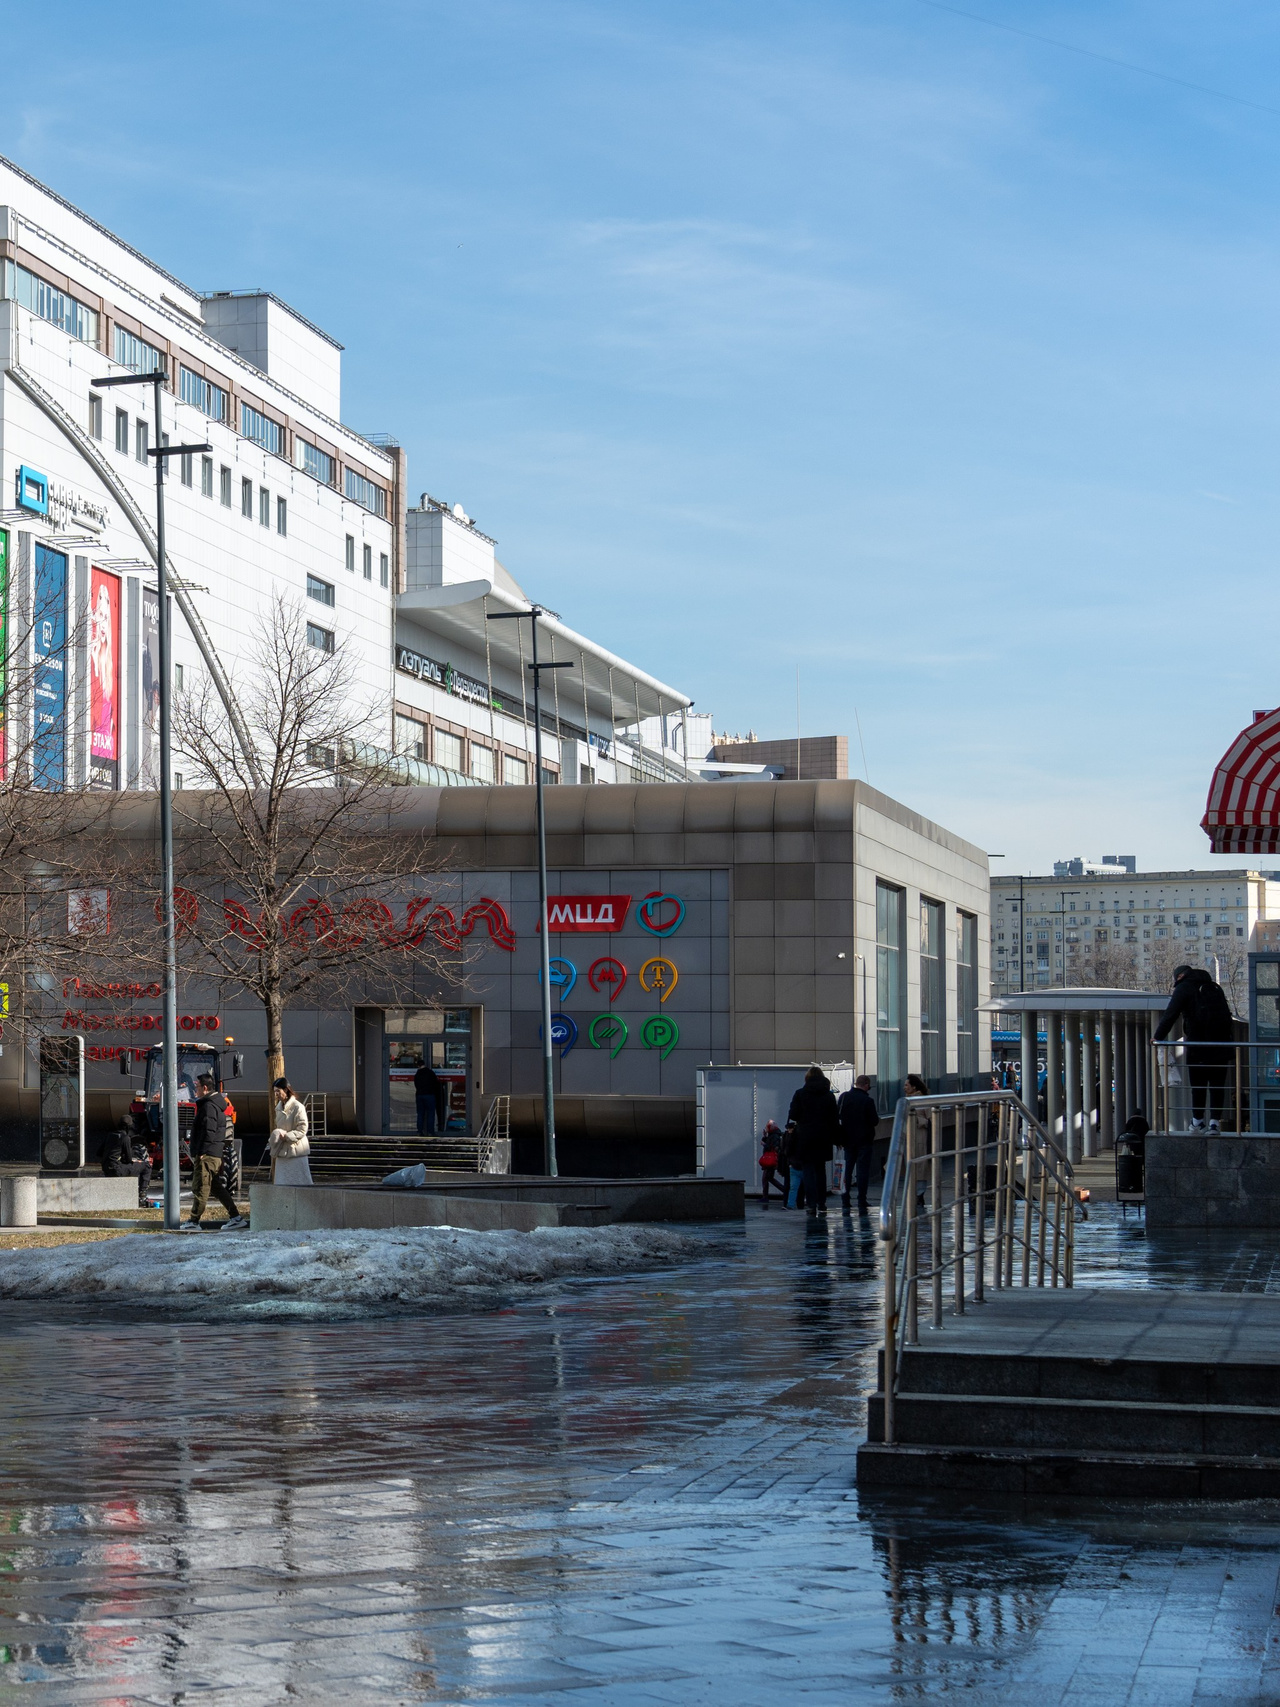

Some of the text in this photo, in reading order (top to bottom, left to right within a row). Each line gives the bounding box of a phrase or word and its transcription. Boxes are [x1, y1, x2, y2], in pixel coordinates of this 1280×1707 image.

[549, 904, 615, 923] МЦД
[63, 977, 161, 998] Павильо
[62, 1010, 220, 1031] Московсого
